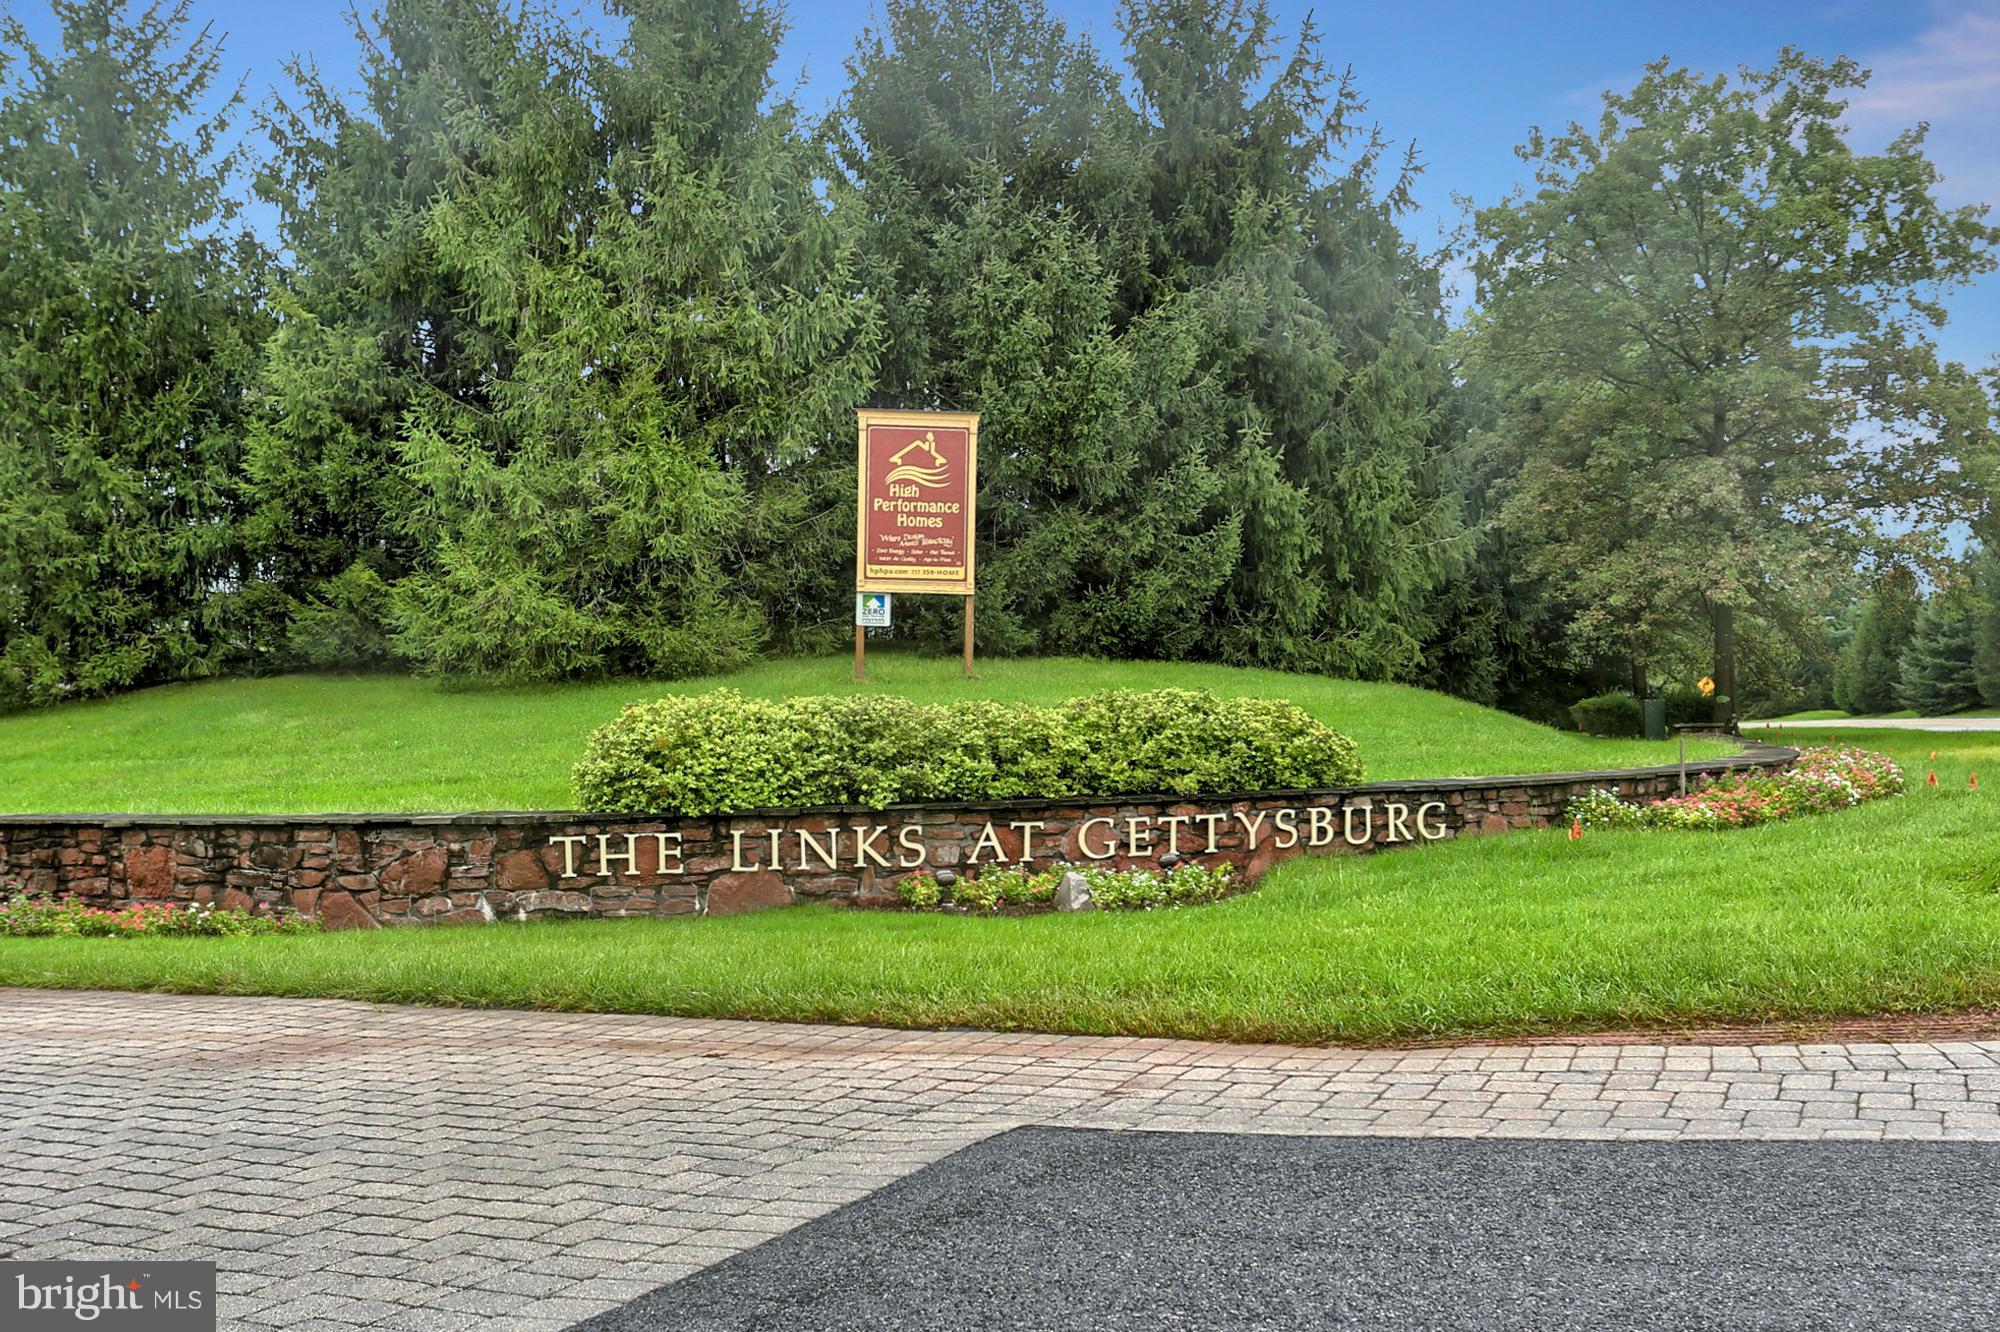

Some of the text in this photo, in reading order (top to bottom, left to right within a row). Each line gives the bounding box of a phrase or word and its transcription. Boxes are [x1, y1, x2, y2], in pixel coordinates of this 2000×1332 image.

[889, 484, 920, 498] High
[873, 498, 960, 513] Performance
[896, 513, 943, 528] Homes
[862, 608, 886, 616] ZERO
[549, 801, 1448, 878] THE LINKS AT GETTYSBURG
